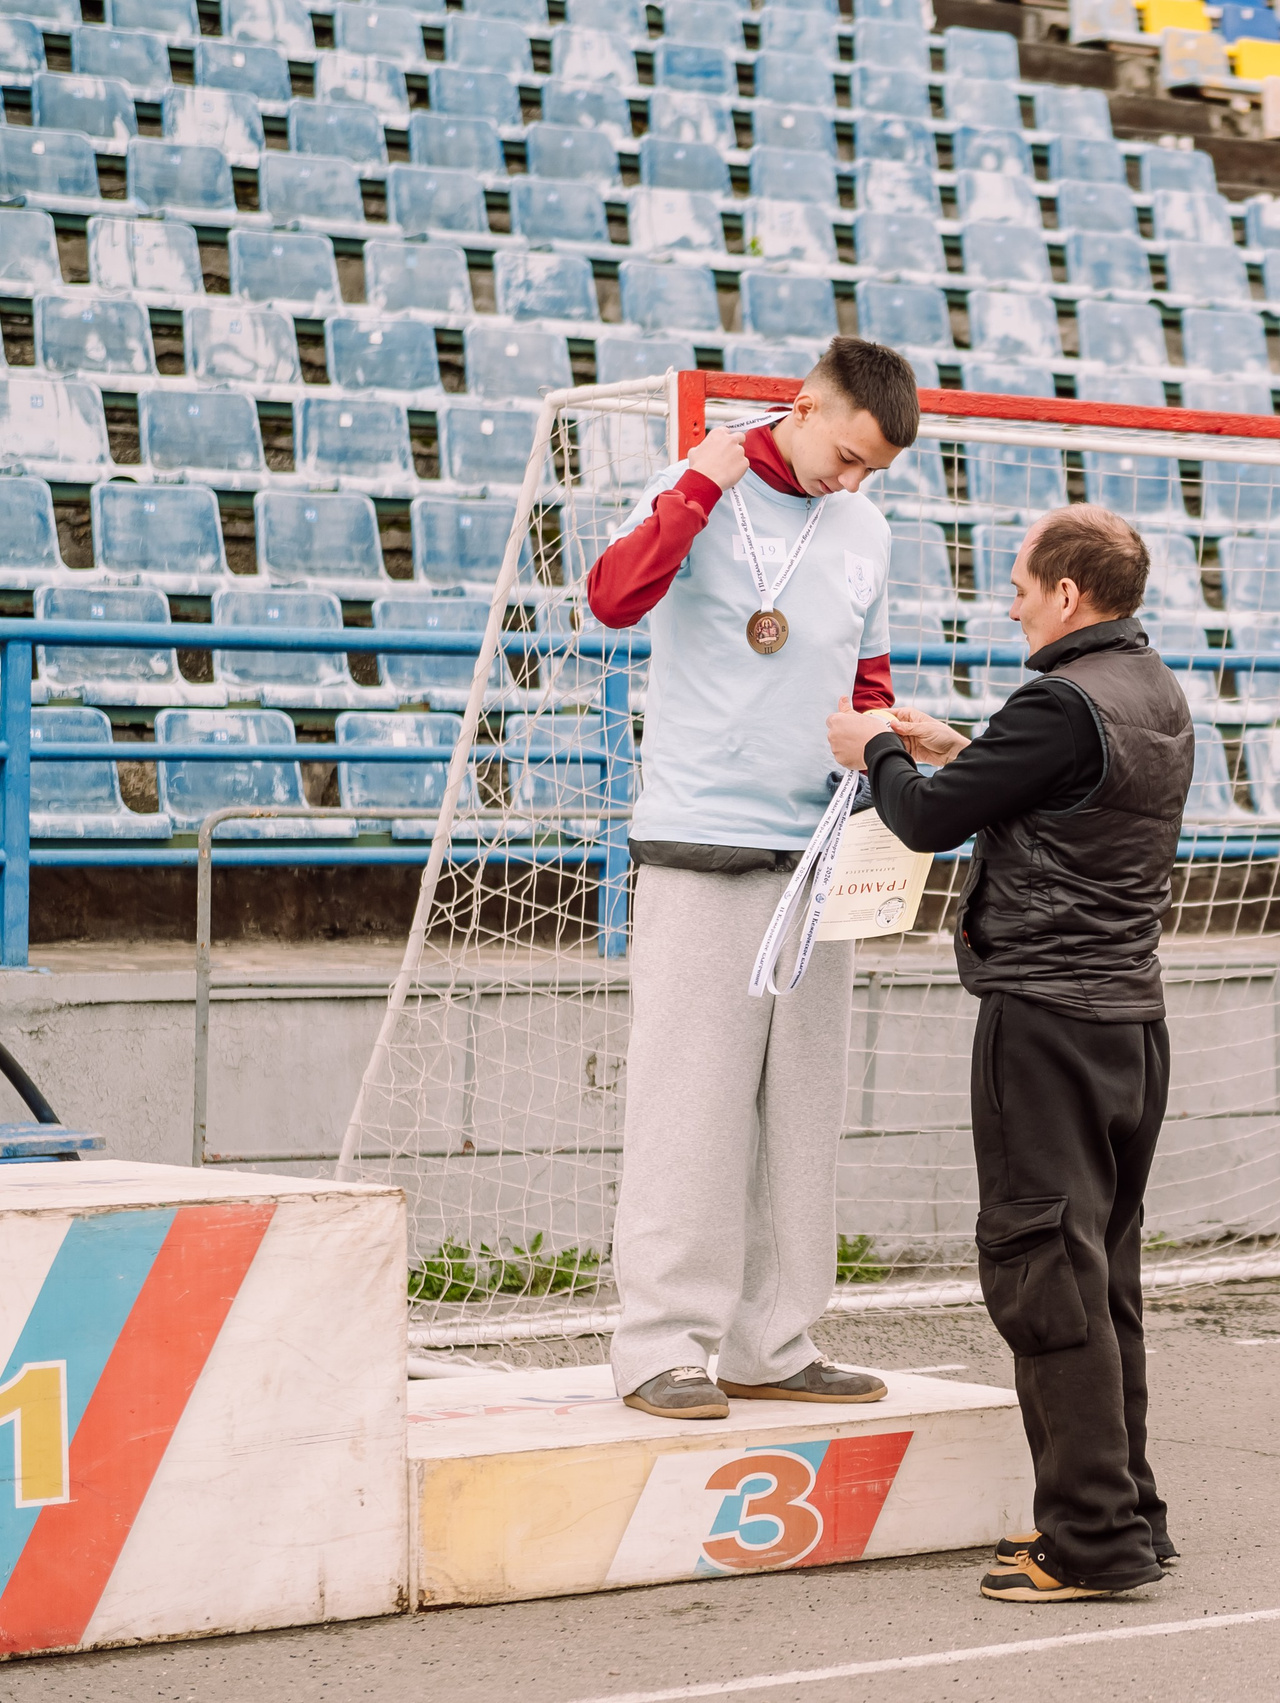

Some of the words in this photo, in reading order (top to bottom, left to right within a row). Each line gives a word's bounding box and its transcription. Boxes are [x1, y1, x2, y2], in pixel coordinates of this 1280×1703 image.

[741, 544, 776, 556] 119
[0, 1360, 69, 1508] 1
[702, 1450, 822, 1572] 3
